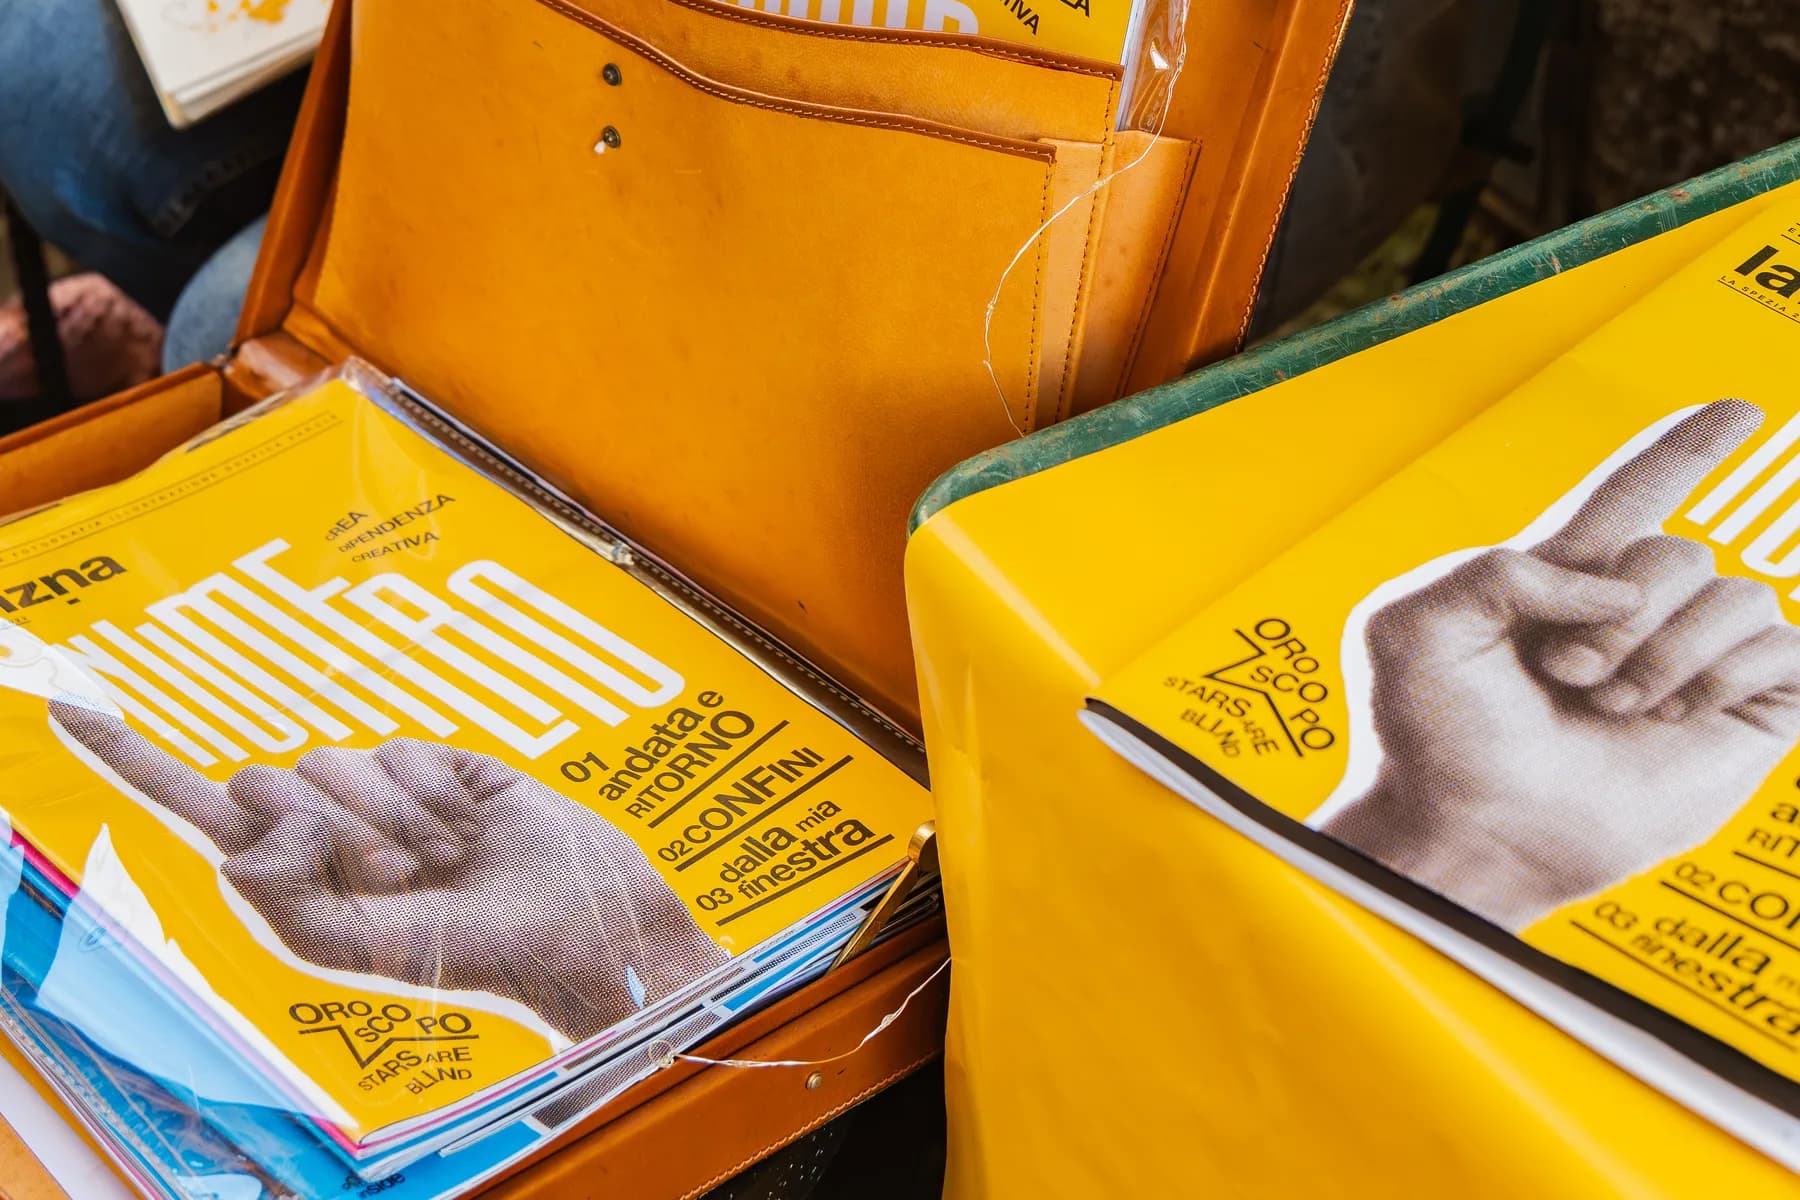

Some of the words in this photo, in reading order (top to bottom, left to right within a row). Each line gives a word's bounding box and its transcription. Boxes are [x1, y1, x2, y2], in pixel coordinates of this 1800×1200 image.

[1720, 275, 1736, 286] LA
[1741, 286, 1787, 312] SPEZIA
[325, 511, 369, 542] CREA
[338, 493, 456, 553] DIPENDENZA
[351, 531, 440, 563] CREATIVA
[1163, 676, 1251, 718] STARS
[597, 704, 702, 802] andata
[697, 689, 724, 709] e
[1180, 709, 1241, 758] BLIND
[560, 751, 610, 784] 01
[625, 710, 755, 819] RITORNO
[719, 825, 796, 884] dalla
[795, 800, 842, 833] mia
[738, 819, 876, 900] finestra
[696, 887, 734, 912] 03
[1654, 916, 1772, 975] dalla
[358, 1050, 423, 1091] STARS
[425, 1046, 472, 1063] ARE
[405, 1067, 473, 1095] BLIND
